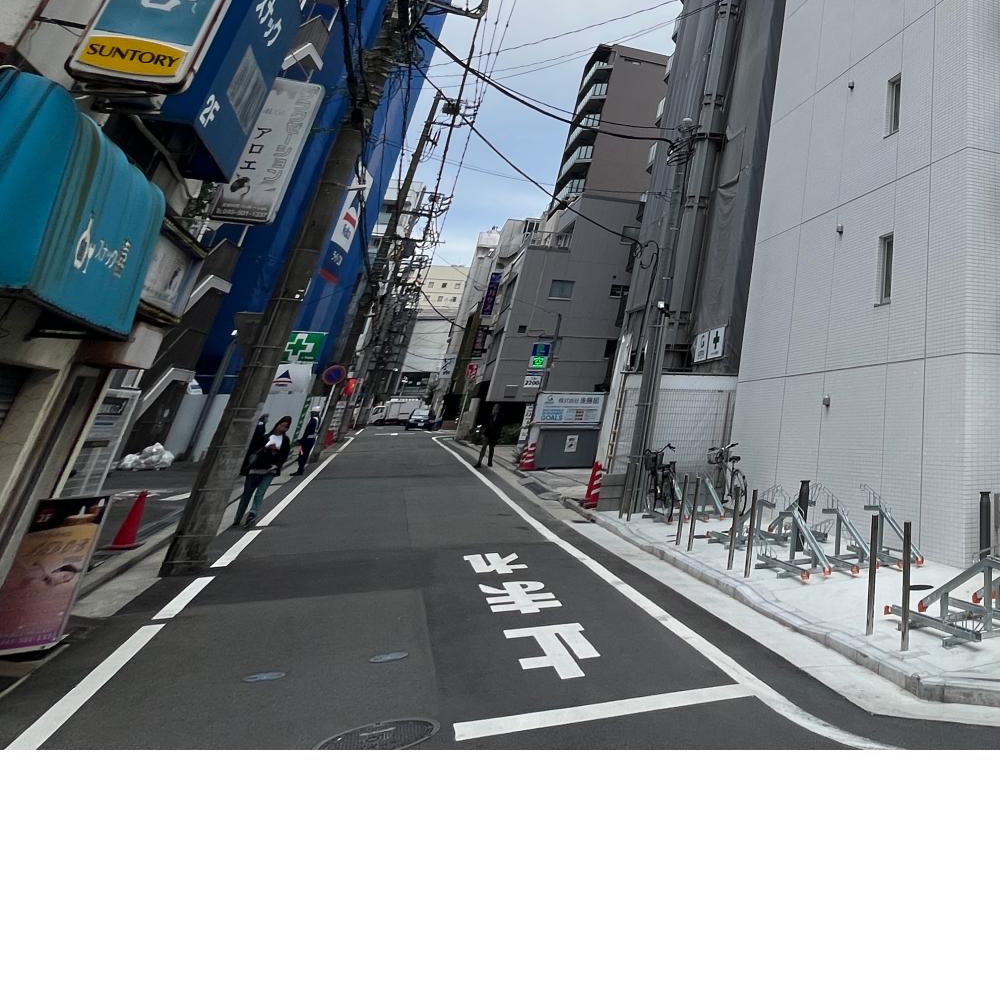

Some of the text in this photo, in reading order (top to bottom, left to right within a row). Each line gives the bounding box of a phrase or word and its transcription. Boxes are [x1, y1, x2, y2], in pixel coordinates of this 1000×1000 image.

[86, 43, 180, 68] SUNTORY
[200, 94, 220, 127] 2F
[240, 127, 272, 170] アロエ
[463, 551, 601, 680] 止まれ
